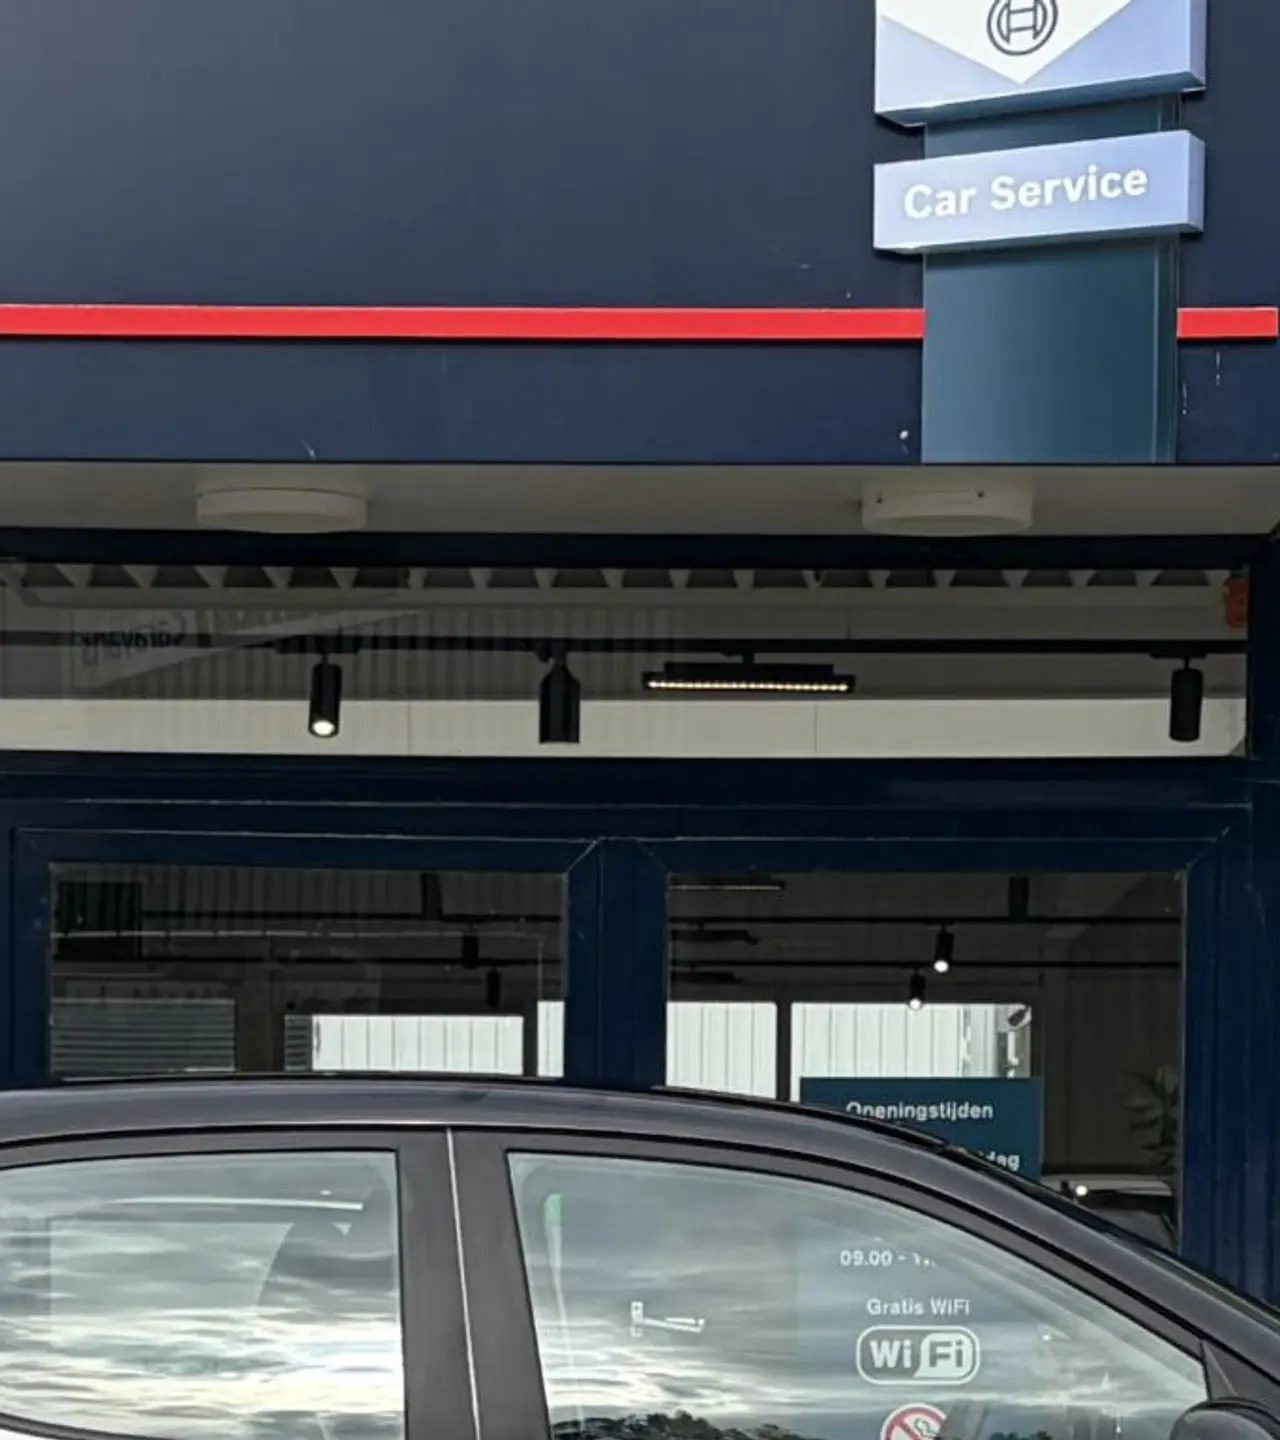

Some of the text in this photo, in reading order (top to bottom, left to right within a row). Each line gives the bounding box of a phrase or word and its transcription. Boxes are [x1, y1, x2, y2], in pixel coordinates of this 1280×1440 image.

[903, 164, 1148, 219] Car Service
[840, 1249, 893, 1267] 09.00
[867, 1298, 970, 1316] Gratis WiFi
